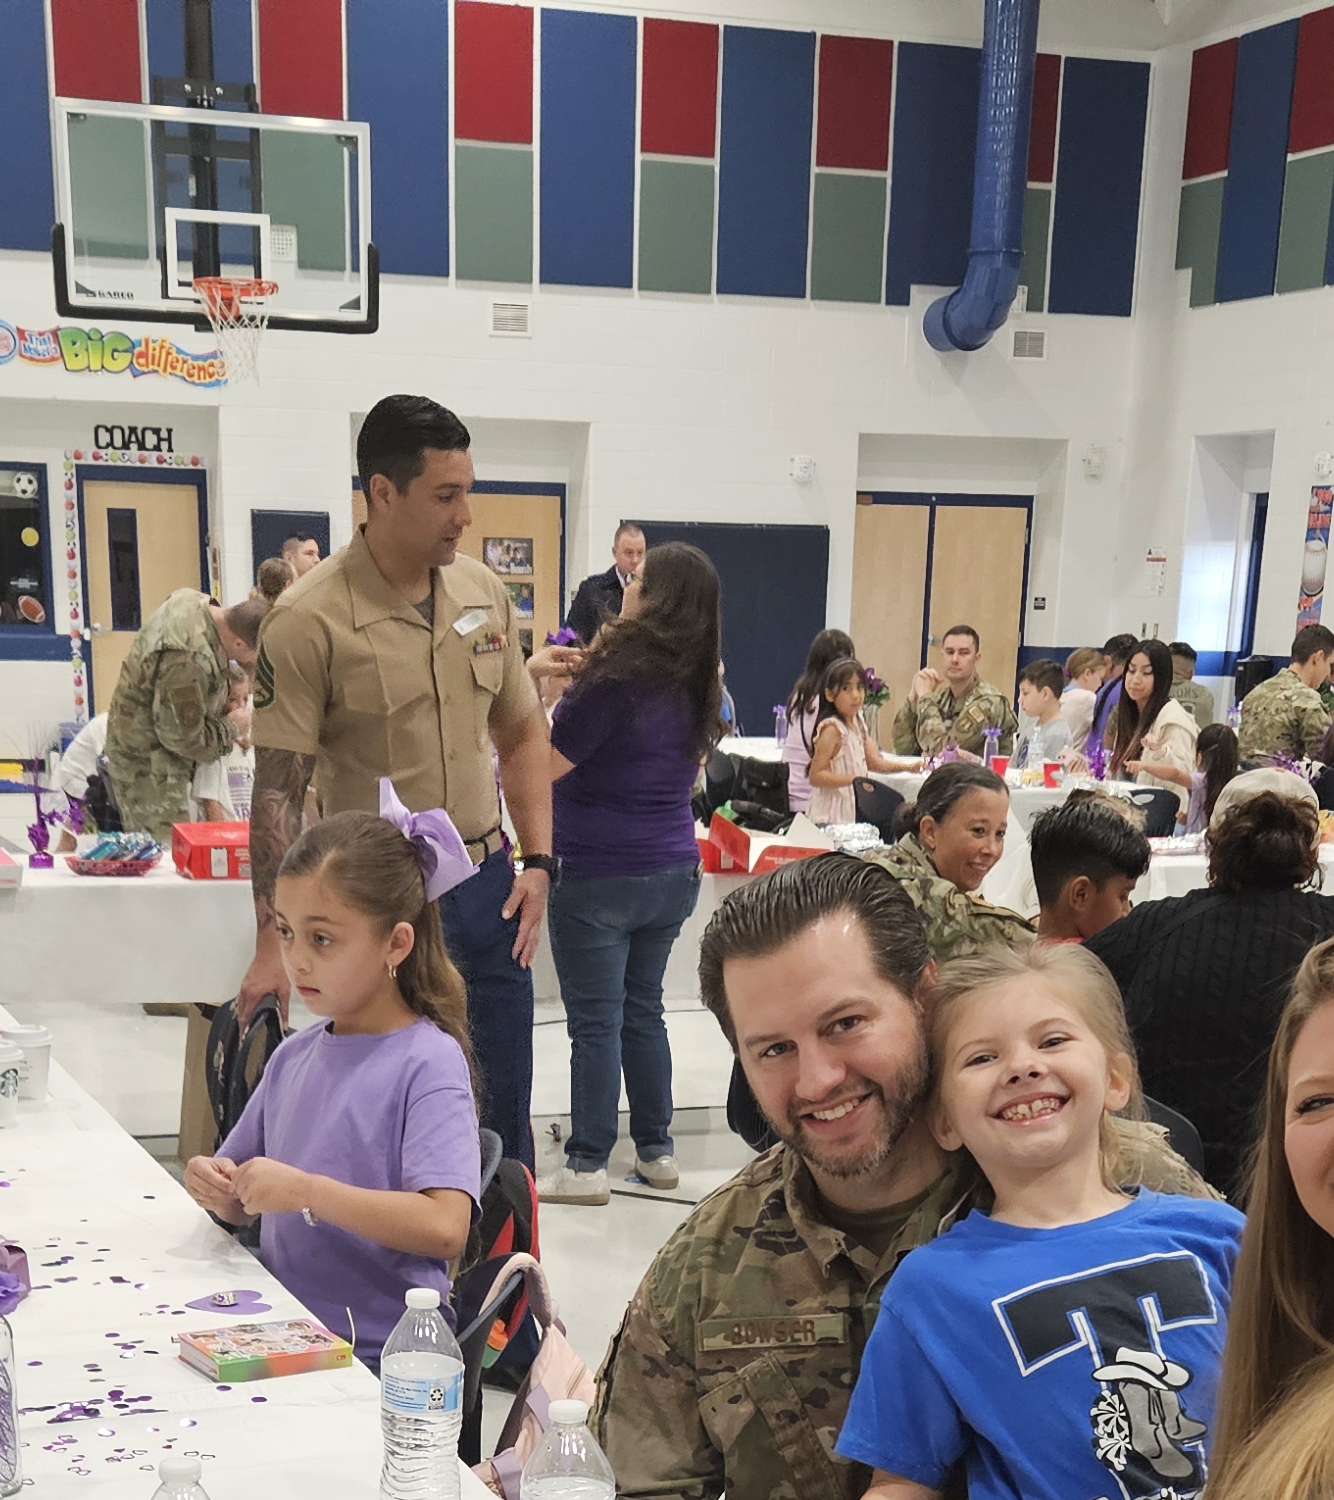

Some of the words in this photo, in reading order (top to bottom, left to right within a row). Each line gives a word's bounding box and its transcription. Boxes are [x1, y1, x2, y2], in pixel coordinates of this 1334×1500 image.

[134, 336, 228, 384] difference
[94, 424, 174, 453] COACH
[732, 1319, 816, 1345] BOWSER
